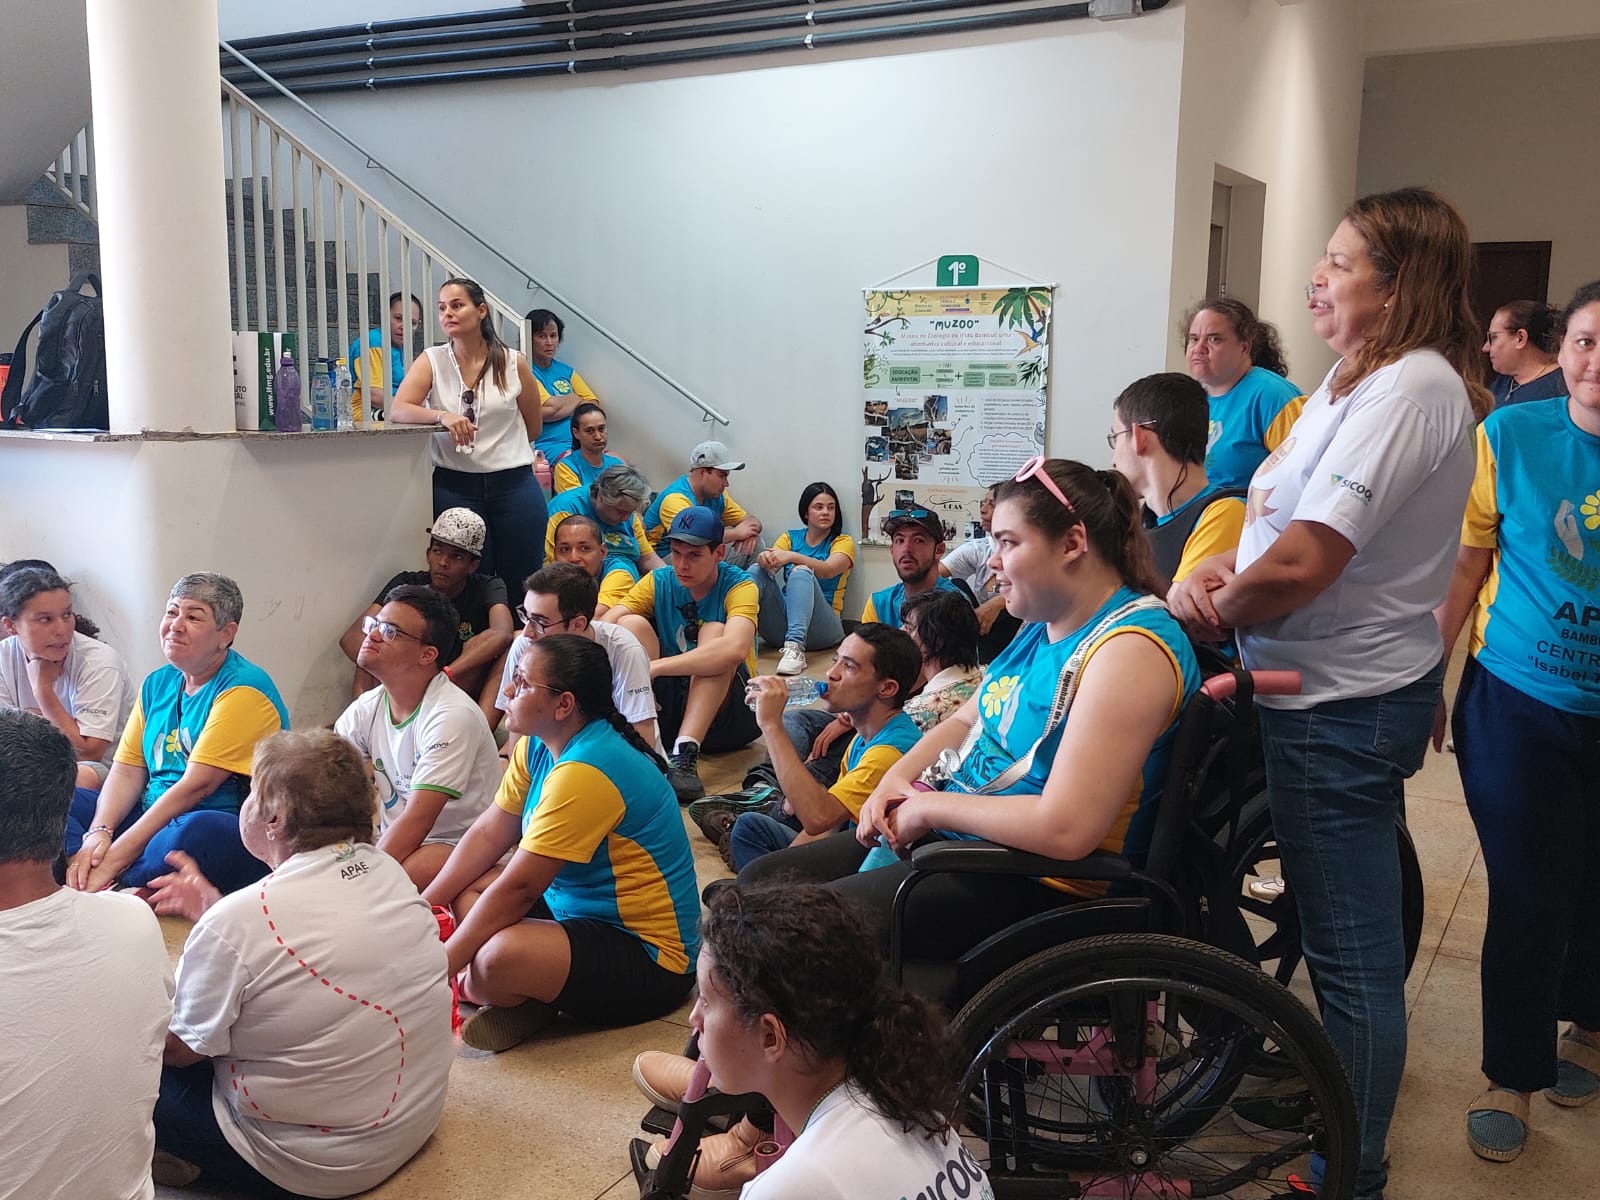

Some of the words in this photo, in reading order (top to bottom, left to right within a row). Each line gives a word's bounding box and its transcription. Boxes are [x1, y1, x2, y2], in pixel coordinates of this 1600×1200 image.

[948, 261, 967, 285] 1º
[263, 346, 275, 416] www.ifmg.edu.br
[1340, 479, 1373, 502] SICOO
[340, 861, 370, 879] APAE
